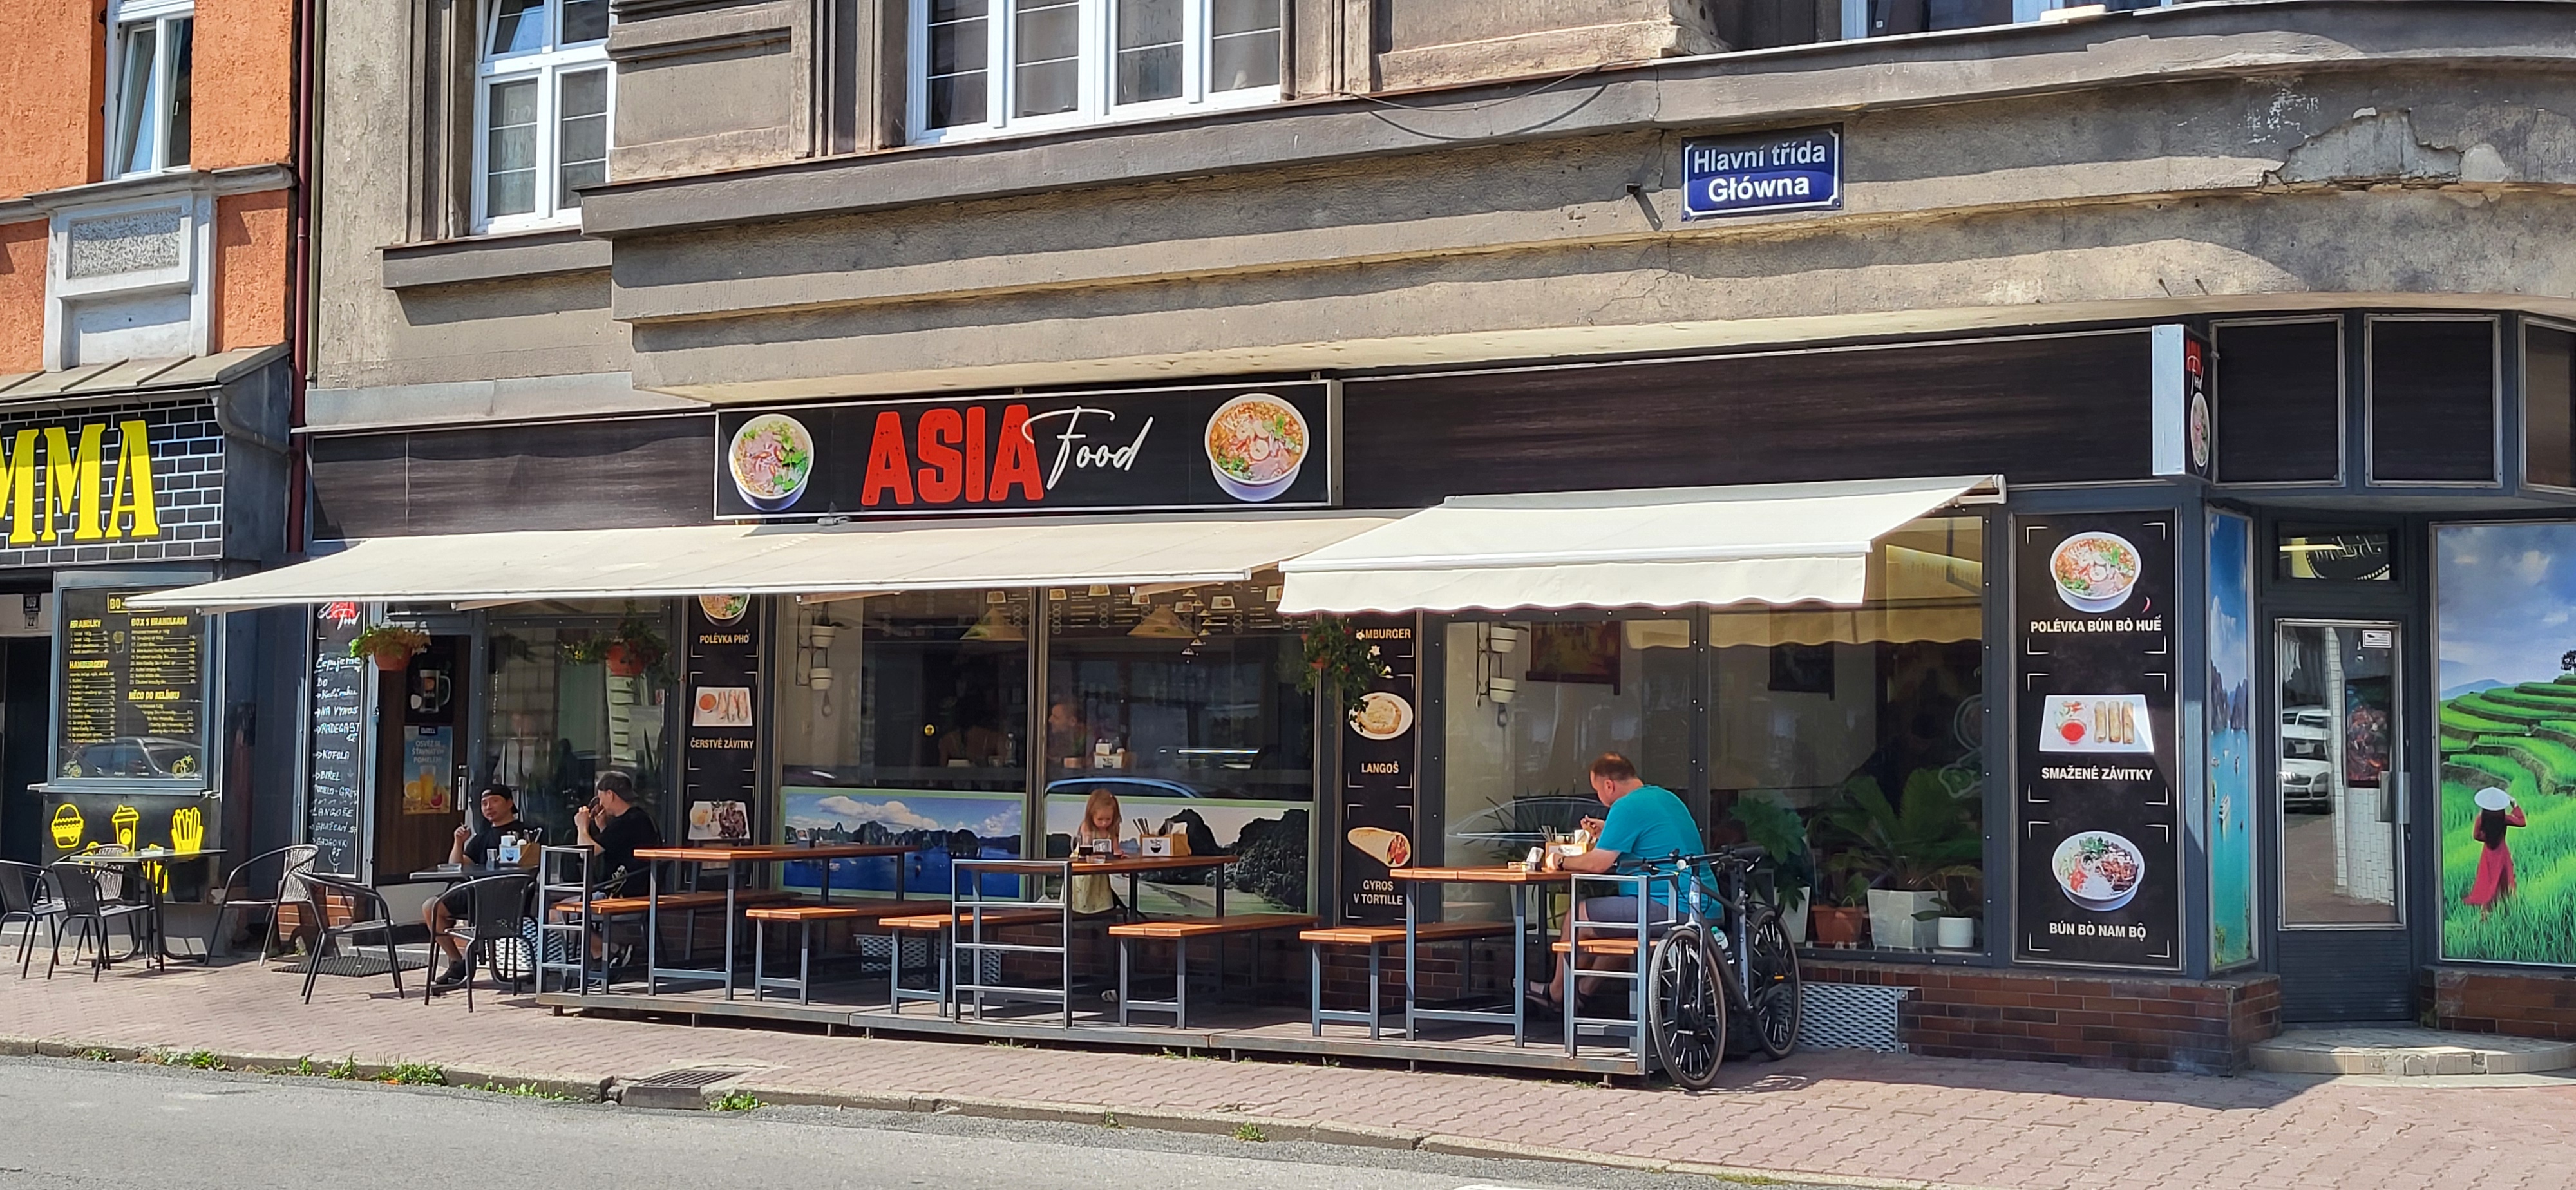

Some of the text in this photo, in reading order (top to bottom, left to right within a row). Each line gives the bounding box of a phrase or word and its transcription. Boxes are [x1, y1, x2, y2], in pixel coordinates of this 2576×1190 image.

[1694, 140, 1826, 173] Hlavní třída
[1708, 176, 1810, 202] Główna
[860, 404, 1154, 506] ASIA Food
[2030, 614, 2162, 633] POLÉVKA BÚN BÒ HUẾ
[699, 633, 732, 644] POLÉVKA
[1357, 628, 1411, 639] MBURGER
[316, 653, 361, 672] Čepujeme
[316, 677, 328, 687] DO
[321, 706, 330, 716] NA
[320, 722, 361, 734] RADEGAST
[690, 737, 754, 749] ČERSTVÉ ZÁVITKY
[322, 750, 350, 760] KOFOLA
[1361, 761, 1399, 773] LANGOŠ
[2041, 764, 2153, 780] SMAŽENÉ ZÁVITKY
[1363, 880, 1394, 891] GYROS
[1353, 893, 1403, 905] V TORTILLE
[2049, 920, 2146, 941] BÚN BÒ NAM BỘ
